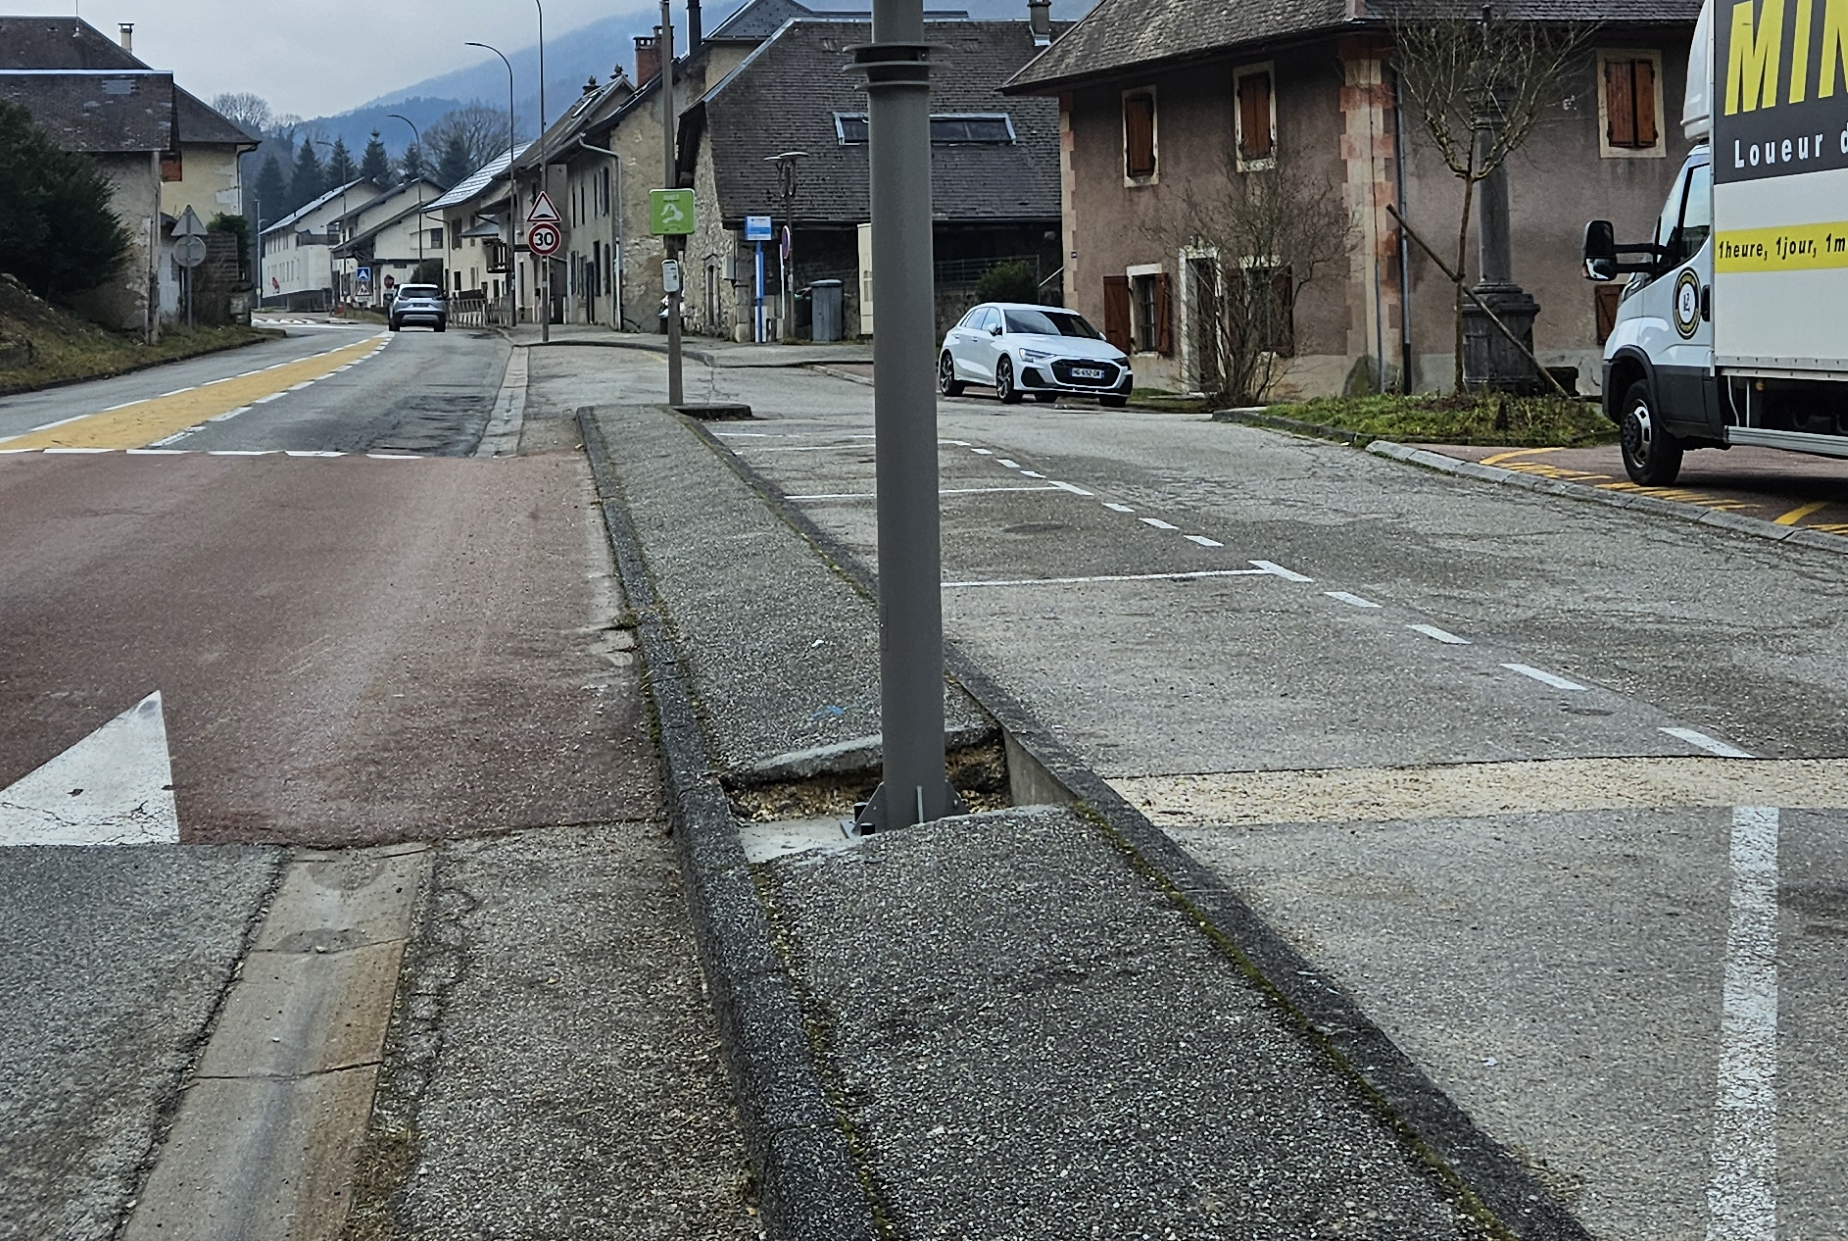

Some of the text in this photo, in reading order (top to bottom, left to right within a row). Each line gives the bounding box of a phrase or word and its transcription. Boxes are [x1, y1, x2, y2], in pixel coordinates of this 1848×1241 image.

[1734, 132, 1824, 169] Loueur
[534, 231, 555, 247] 30
[1719, 240, 1768, 261] 1heure,
[1775, 236, 1817, 261] 1jour,
